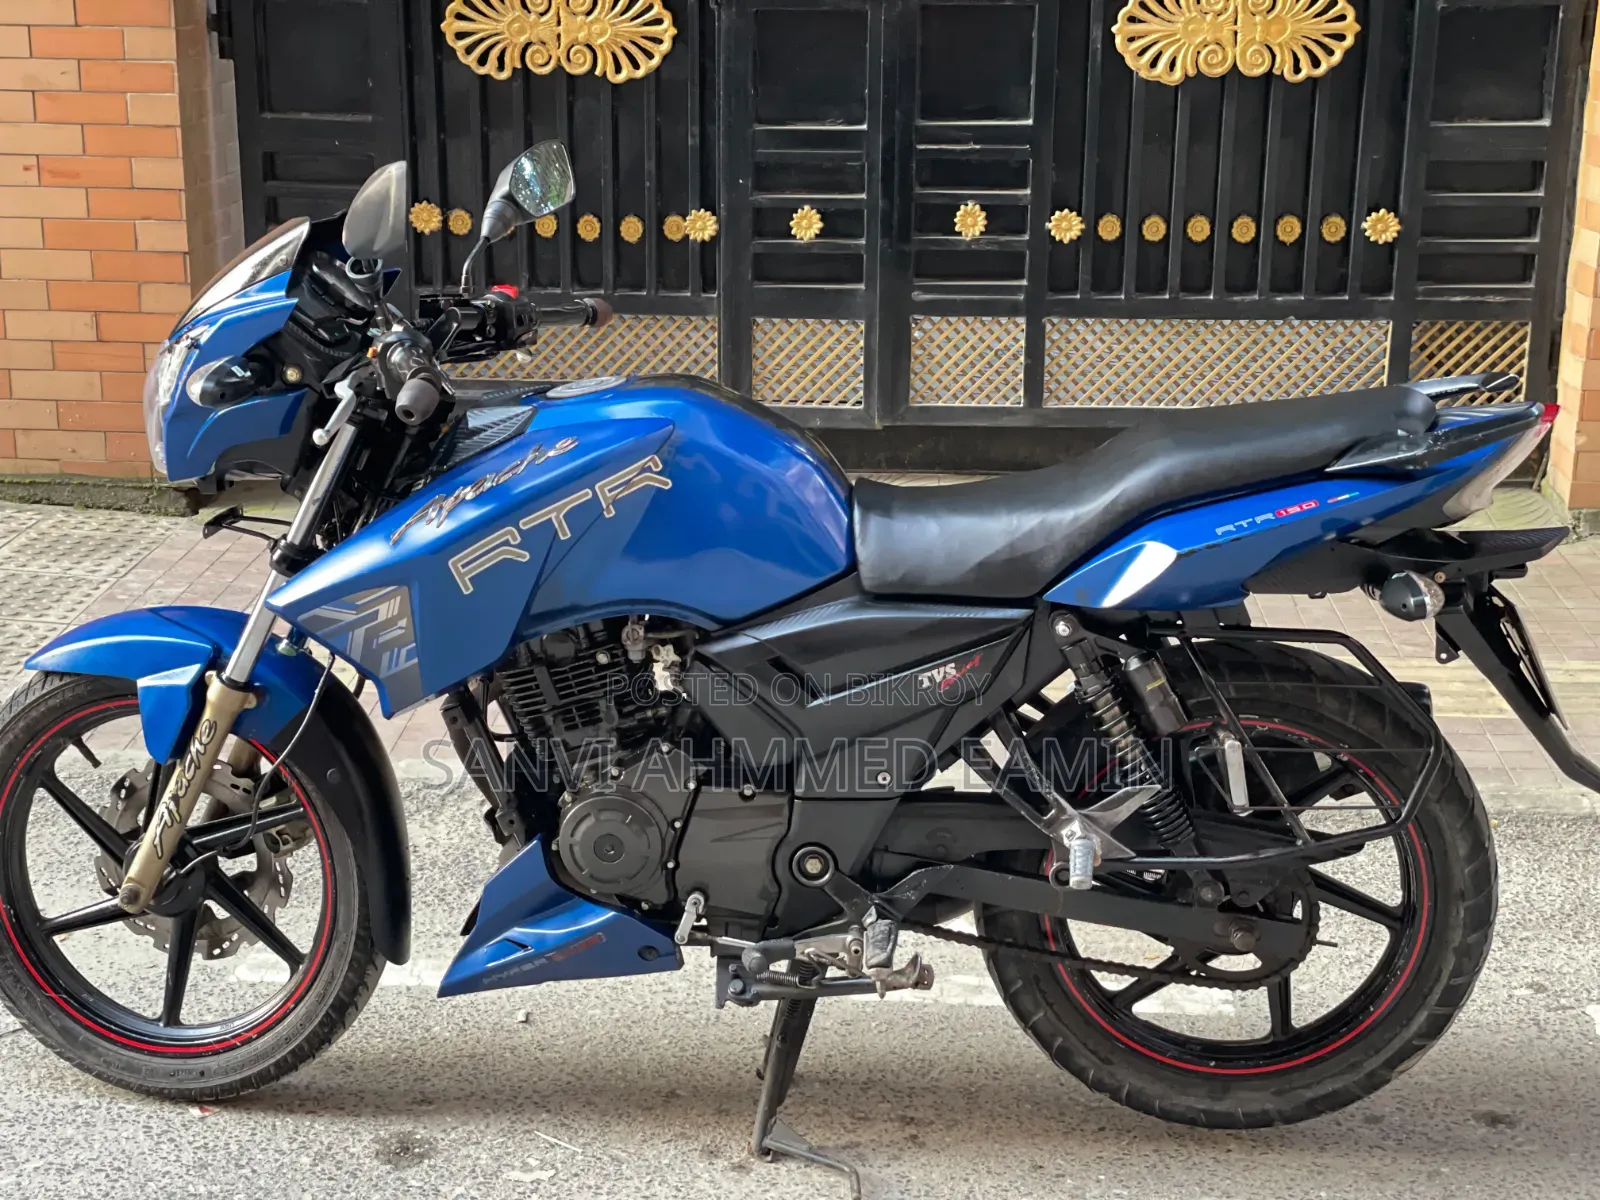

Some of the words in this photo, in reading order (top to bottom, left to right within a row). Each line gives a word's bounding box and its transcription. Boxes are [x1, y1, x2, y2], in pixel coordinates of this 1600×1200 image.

[448, 454, 672, 595] RTR
[1215, 512, 1275, 536] RTR
[919, 662, 956, 689] TVS
[153, 718, 218, 860] Apache
